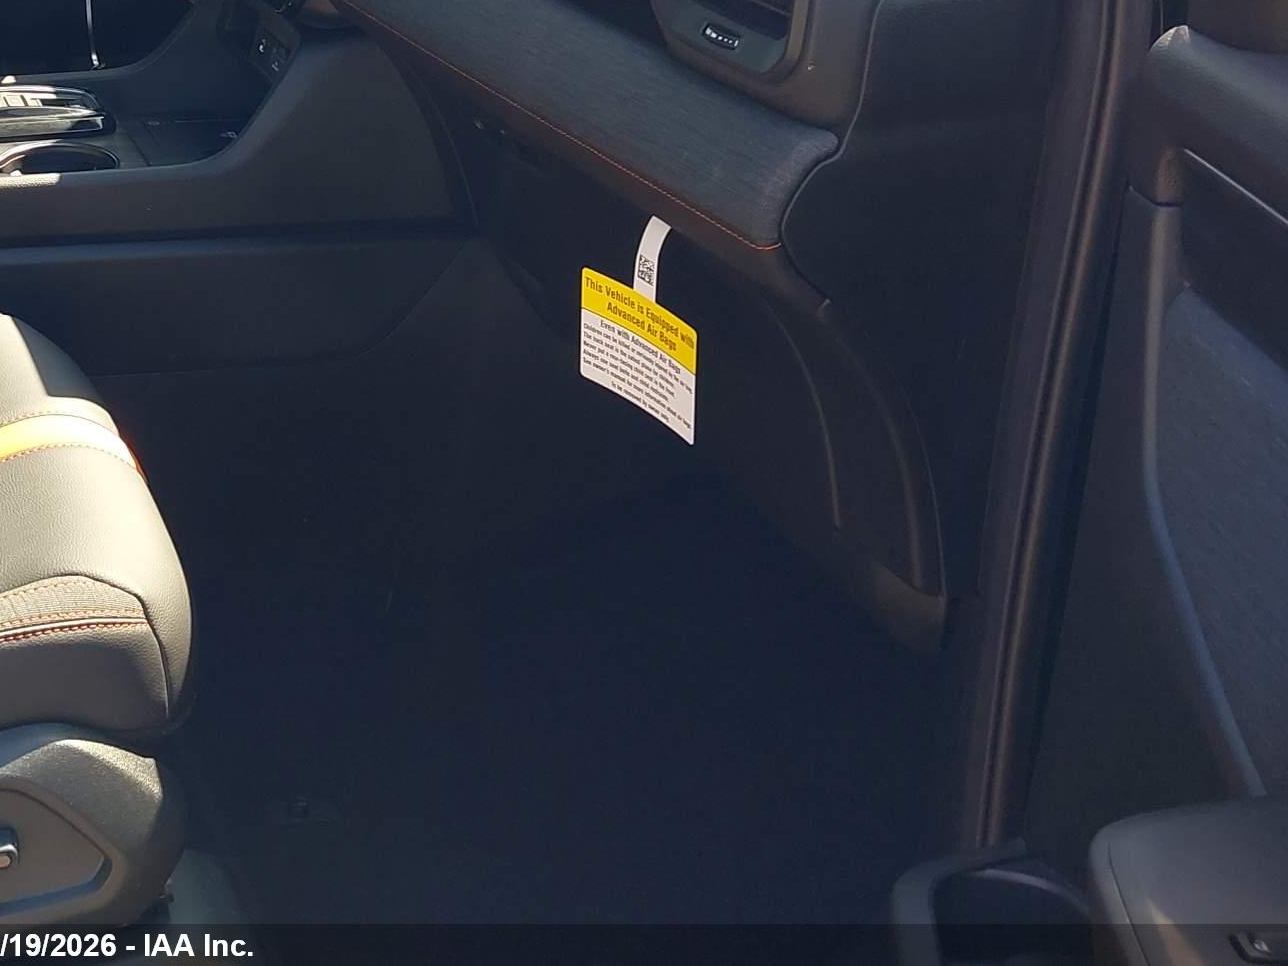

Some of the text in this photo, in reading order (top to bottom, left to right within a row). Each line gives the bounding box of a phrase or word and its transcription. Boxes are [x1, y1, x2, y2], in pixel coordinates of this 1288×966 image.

[585, 276, 694, 349] This Vehicle is Equipped with
[607, 302, 676, 351] Advanced Air Bags
[600, 320, 614, 333] Even
[617, 328, 629, 340] with
[631, 335, 657, 358] Advanced
[668, 359, 680, 375] Bags
